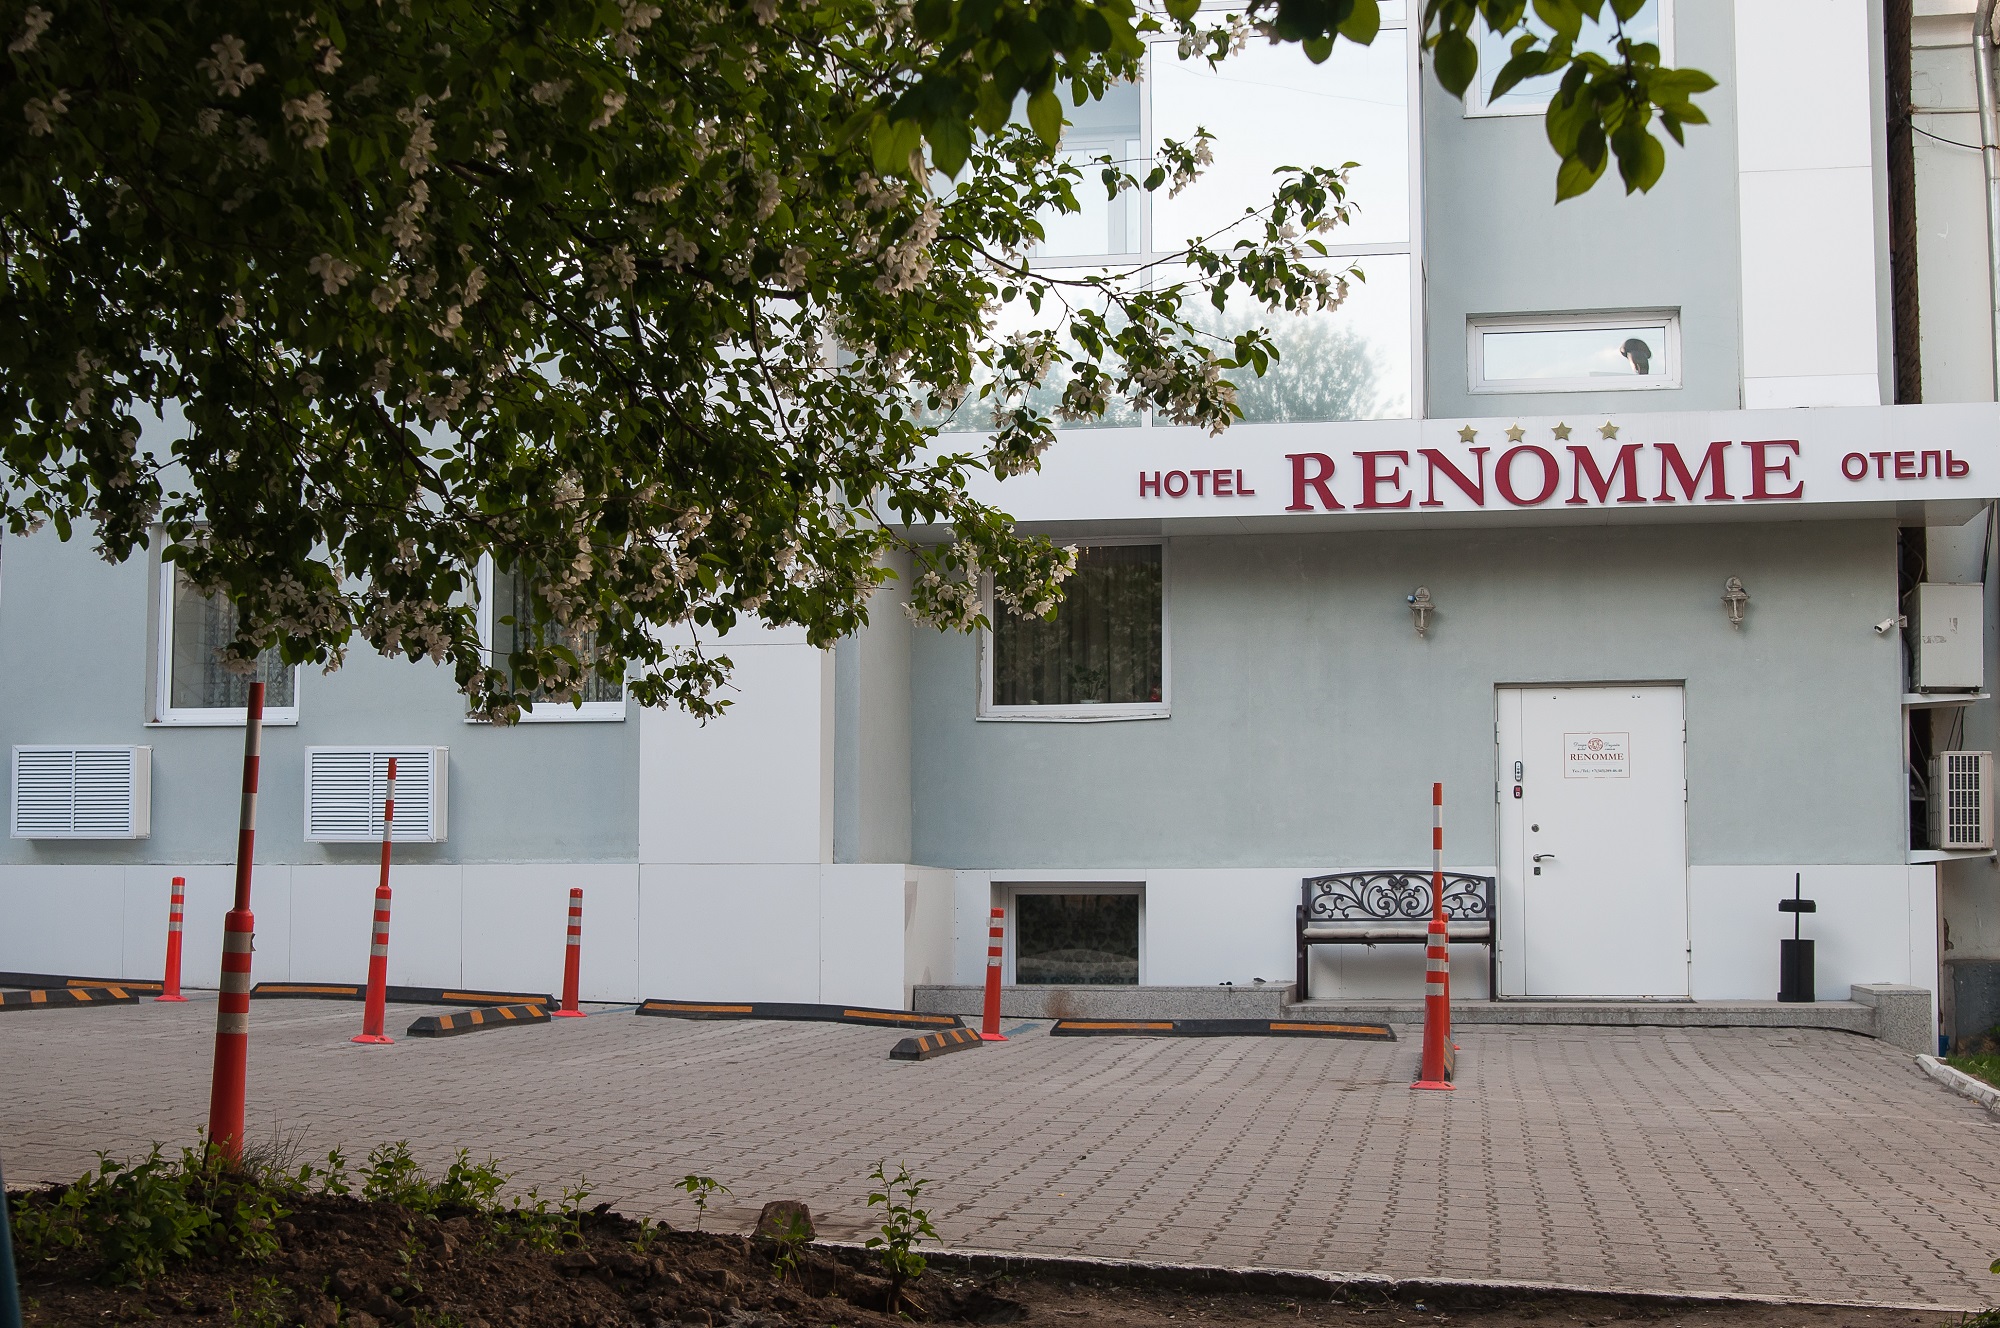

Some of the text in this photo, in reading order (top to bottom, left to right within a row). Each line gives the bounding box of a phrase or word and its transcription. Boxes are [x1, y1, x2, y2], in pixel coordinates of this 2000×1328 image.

[1139, 440, 1804, 511] HOTEL RENOMME
[1841, 449, 1971, 481] ОТЕЛЬ
[1570, 753, 1624, 761] RENOMME
